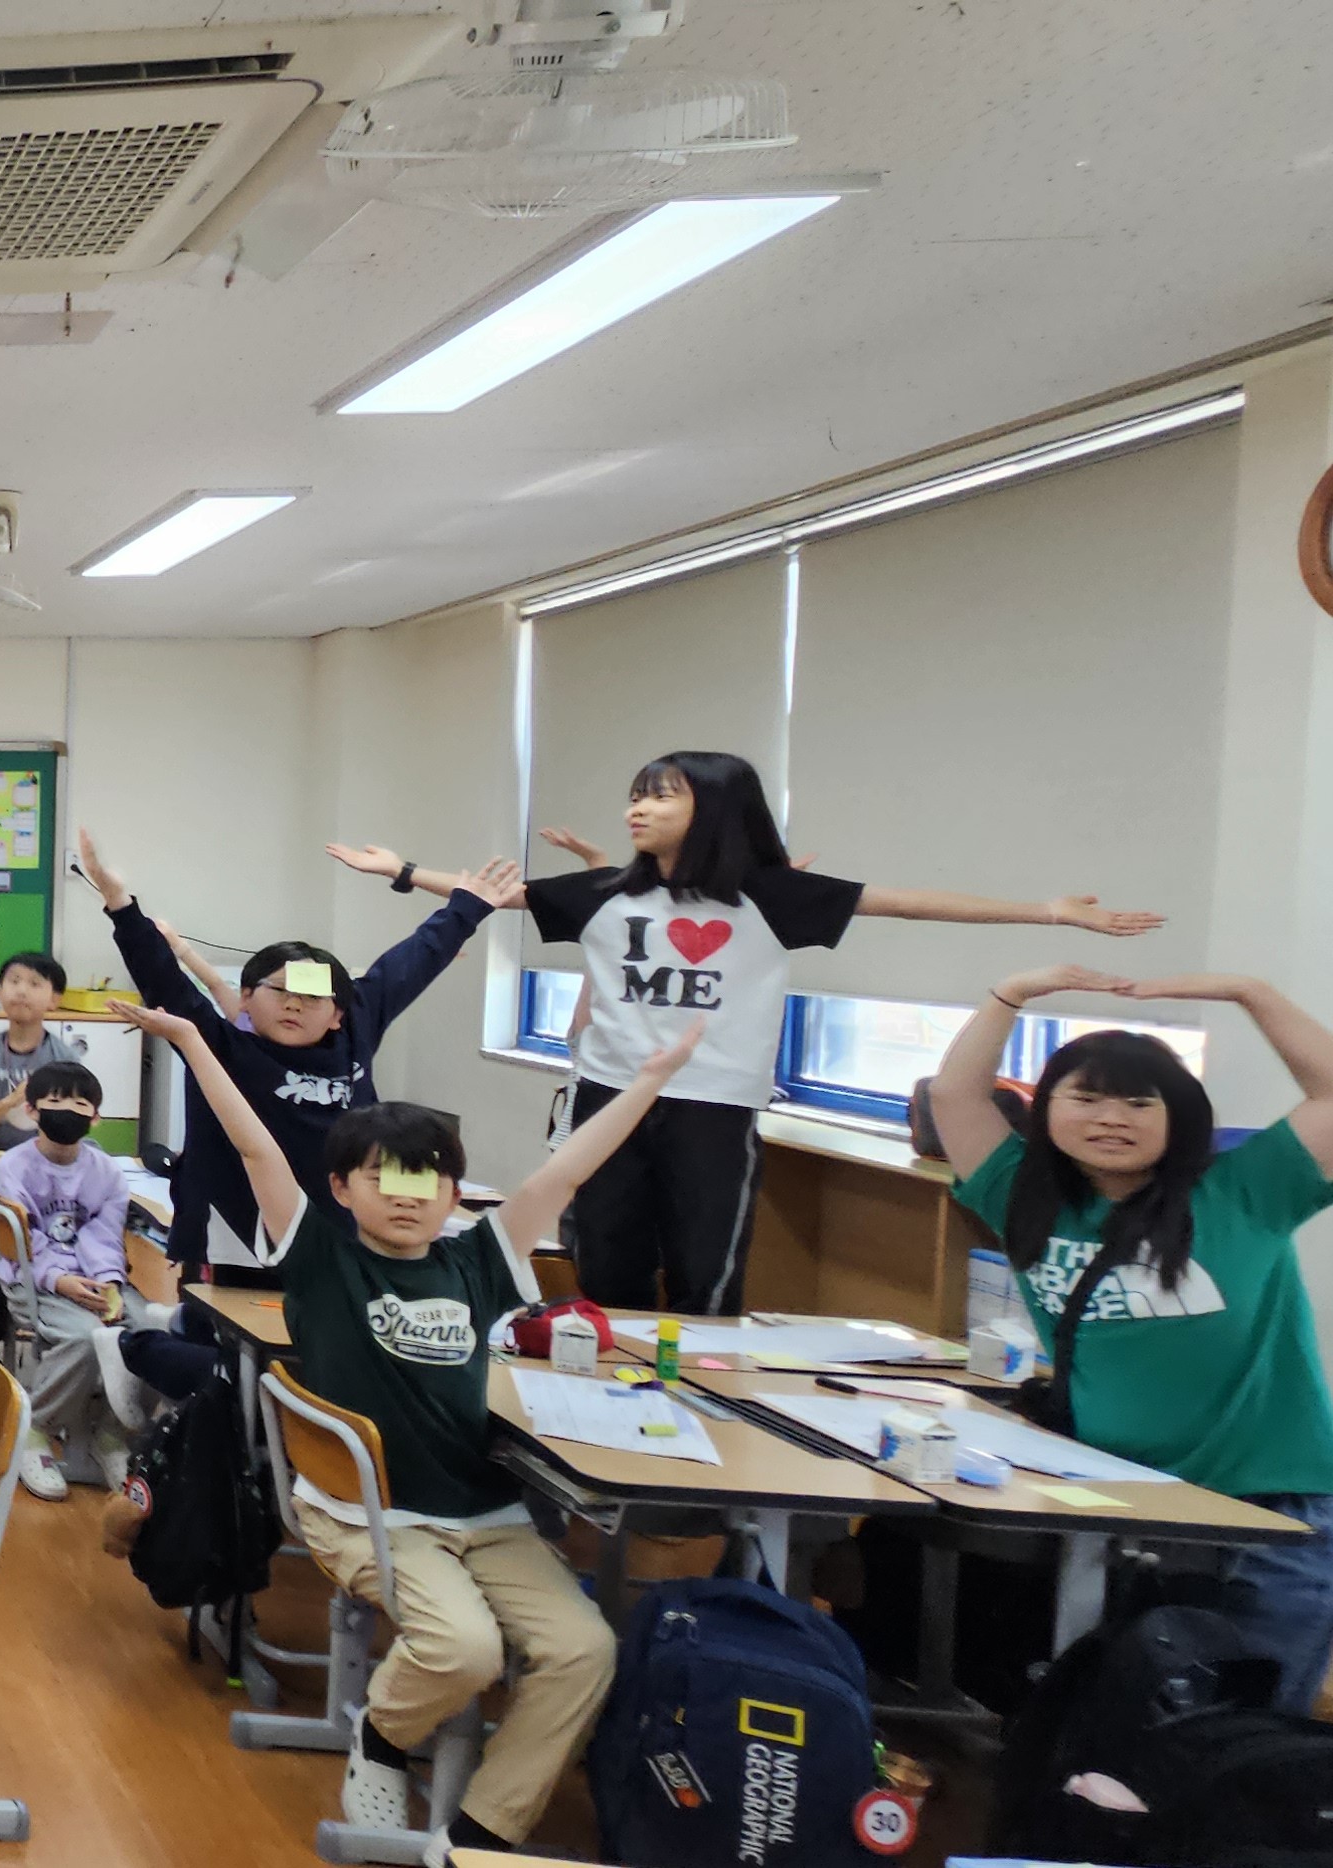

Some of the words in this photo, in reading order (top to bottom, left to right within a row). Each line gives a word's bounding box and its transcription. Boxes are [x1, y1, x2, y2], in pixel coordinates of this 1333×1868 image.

[623, 916, 654, 961] I
[619, 965, 722, 1011] ME
[415, 1310, 442, 1323] GEAR
[738, 1743, 771, 1867] GEOGRAPHIC
[768, 1749, 799, 1844] NATIONAL
[871, 1811, 901, 1833] 30
